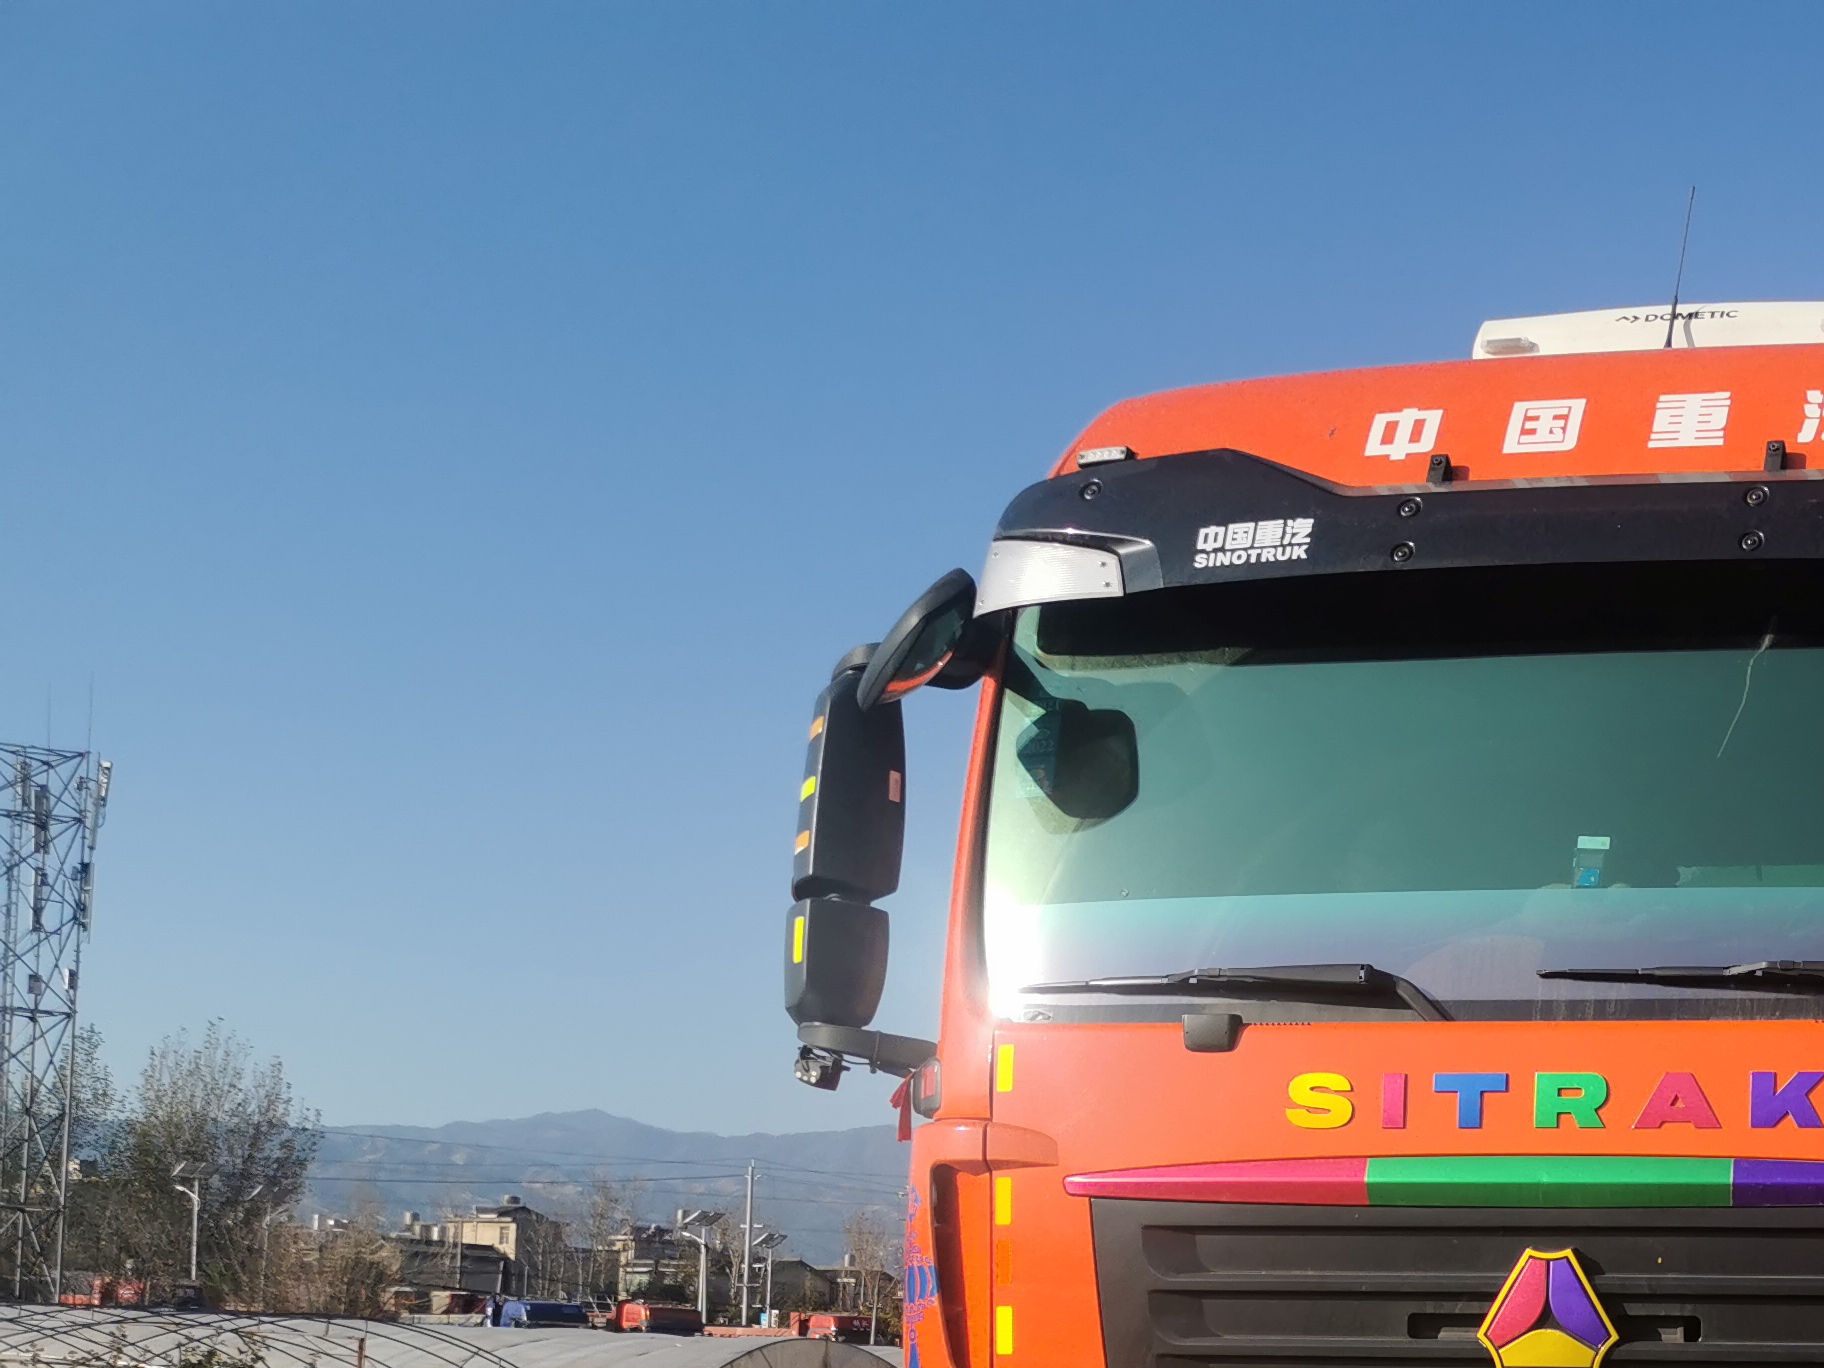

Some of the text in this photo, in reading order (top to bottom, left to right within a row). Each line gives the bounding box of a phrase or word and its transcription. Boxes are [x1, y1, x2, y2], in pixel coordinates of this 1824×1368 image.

[1644, 310, 1739, 322] DOMETIC
[1196, 517, 1315, 551] 中国重汽
[1193, 544, 1309, 568] SINOTRUK
